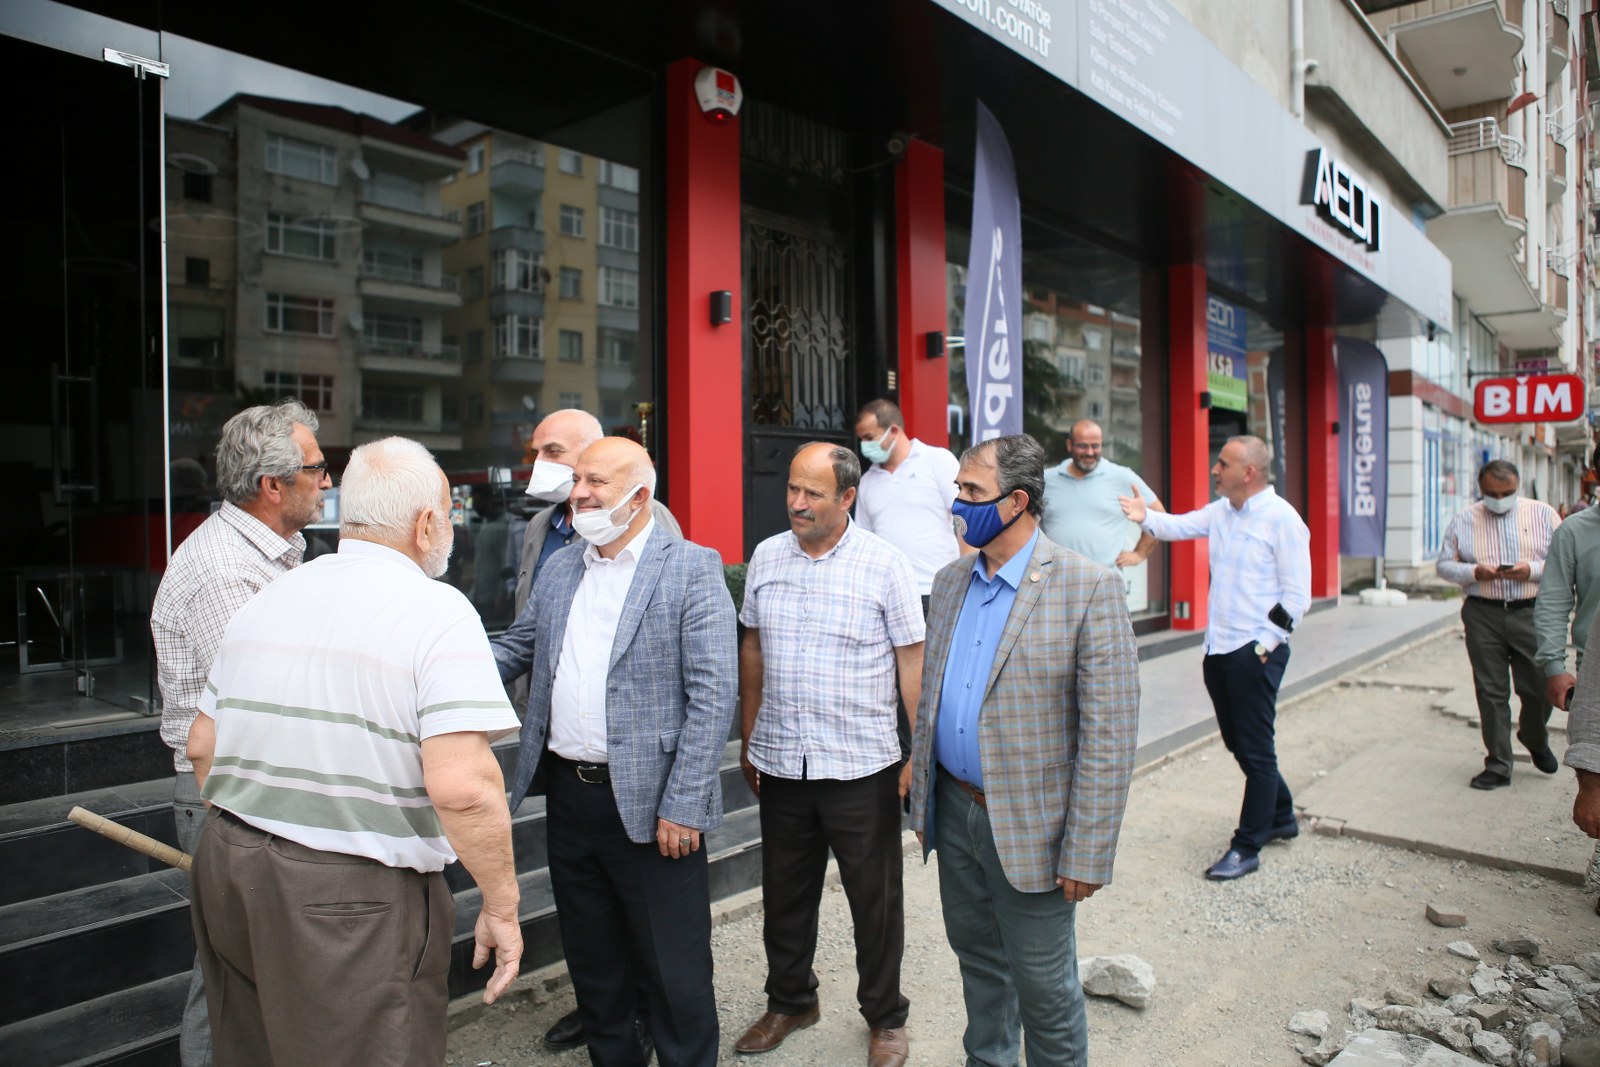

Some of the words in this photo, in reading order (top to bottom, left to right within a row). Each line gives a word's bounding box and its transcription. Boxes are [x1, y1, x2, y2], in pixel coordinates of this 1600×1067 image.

[1206, 297, 1236, 332] EON
[1206, 350, 1234, 377] ksa
[1483, 376, 1572, 417] BİM
